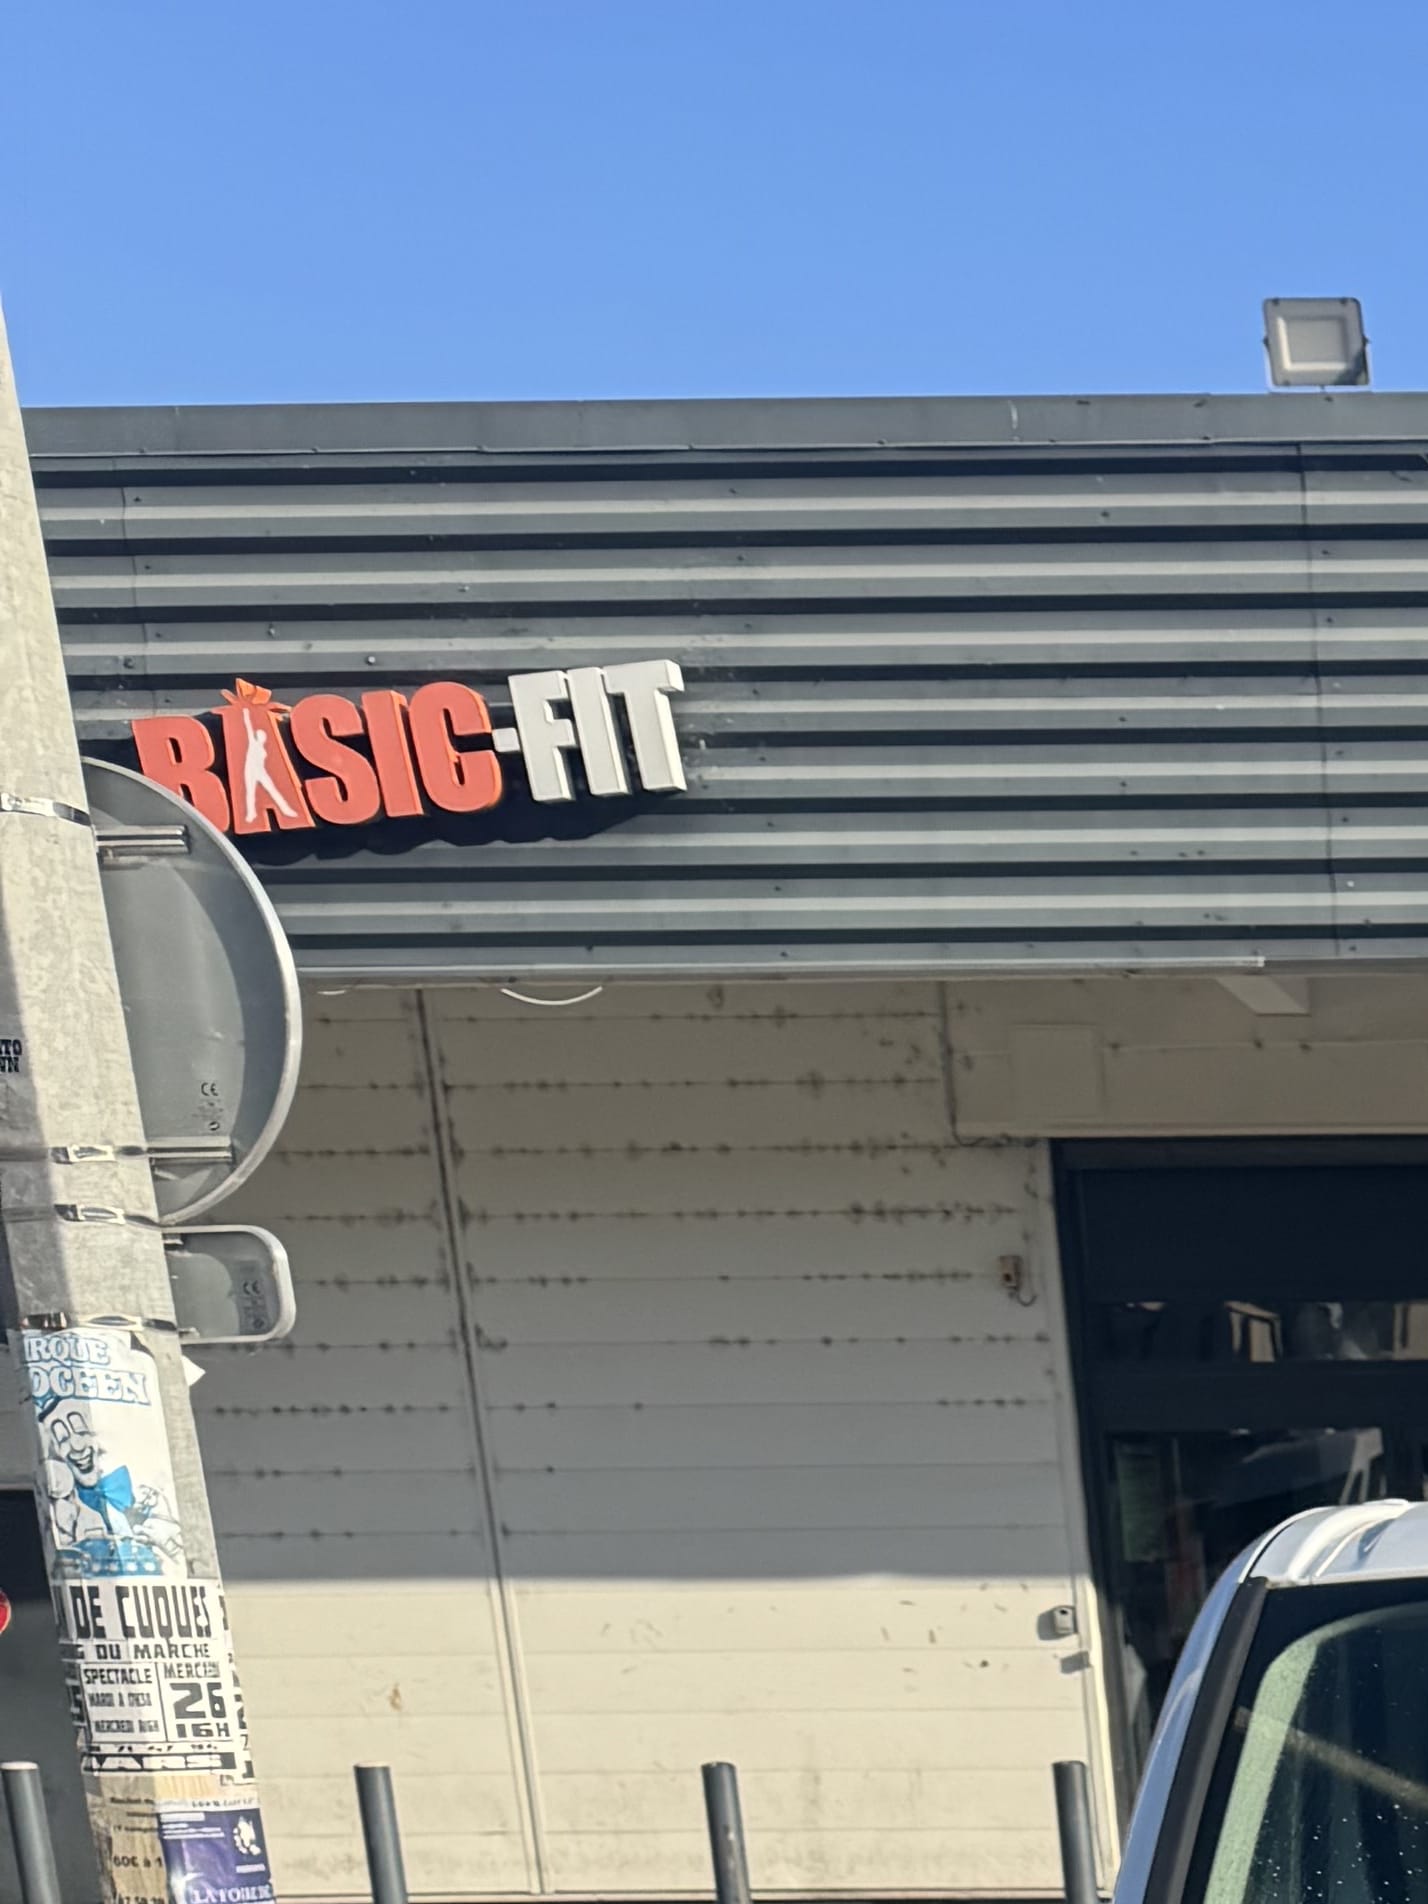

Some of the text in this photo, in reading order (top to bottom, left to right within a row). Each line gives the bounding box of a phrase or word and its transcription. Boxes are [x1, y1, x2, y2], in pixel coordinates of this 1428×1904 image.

[132, 659, 688, 835] BASIC-FIT
[25, 1335, 111, 1367] IRQUE
[69, 1584, 107, 1639] DE
[115, 1584, 212, 1645] CUQUES
[95, 1643, 122, 1660] DU
[134, 1642, 211, 1659] MARCHE
[84, 1667, 153, 1685] SPECTACLE
[169, 1681, 228, 1720] 26
